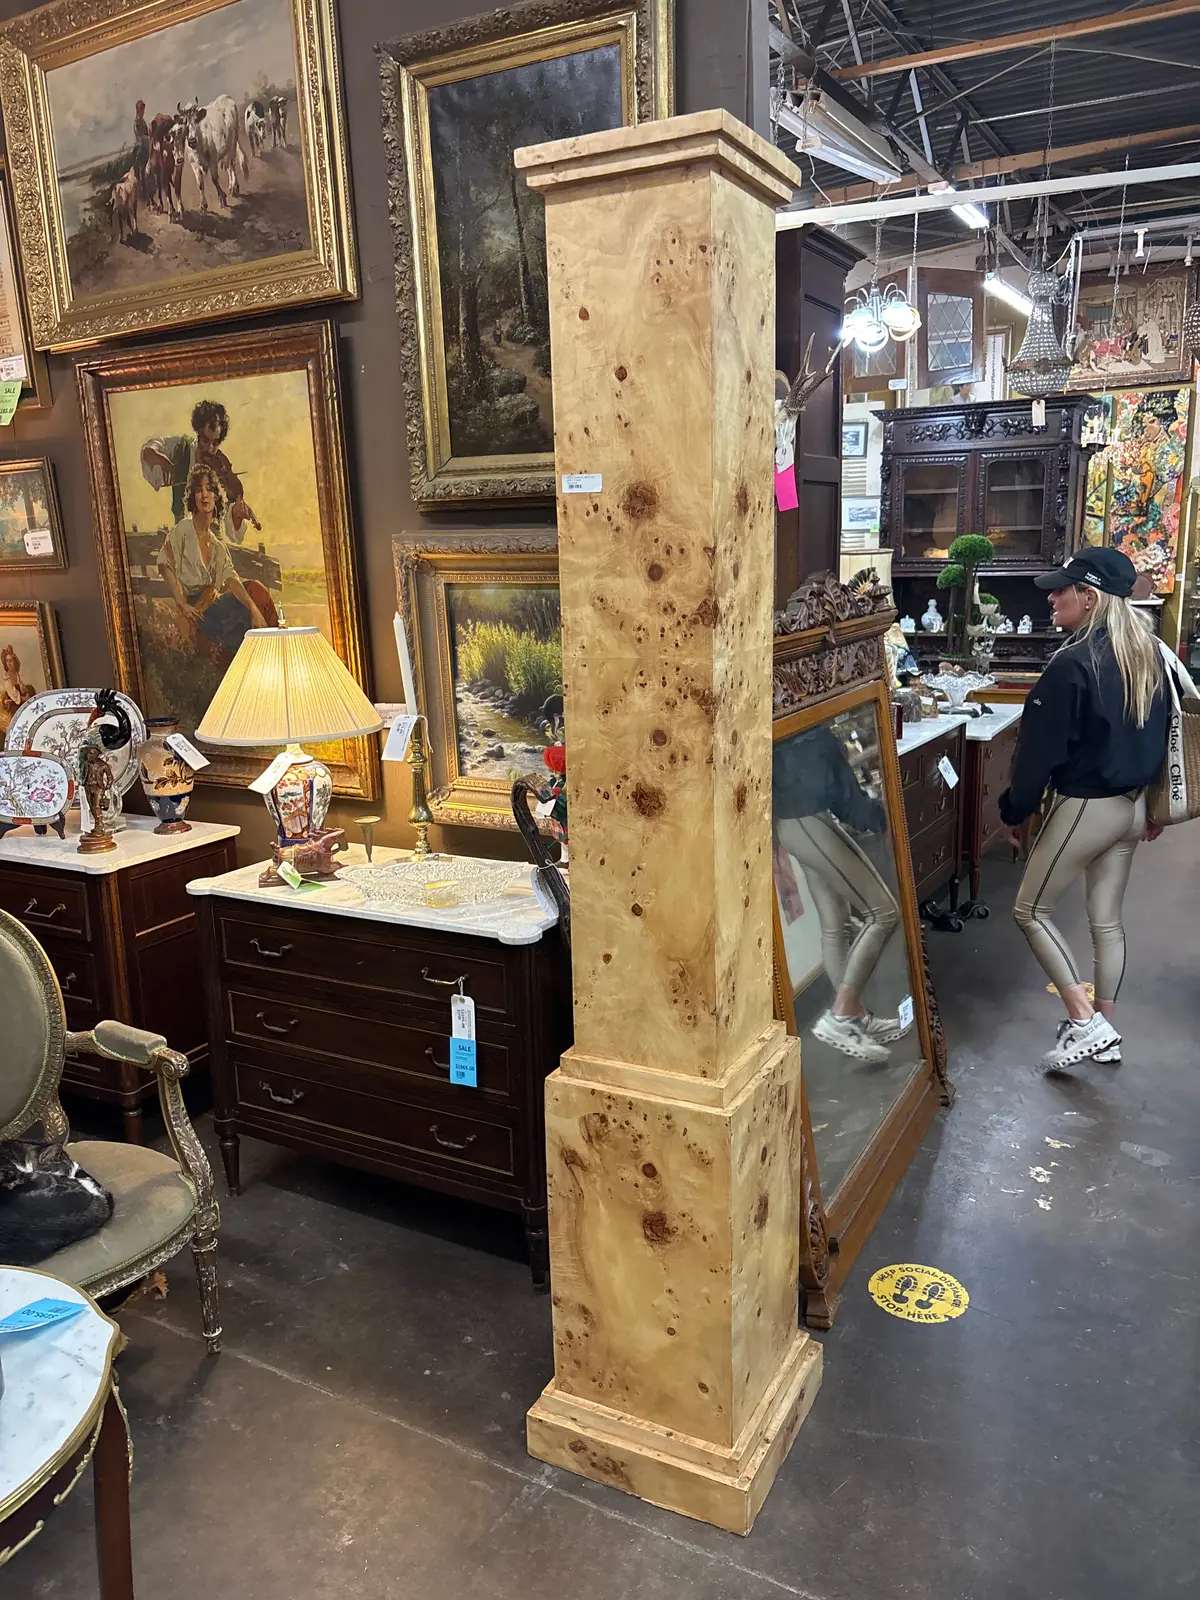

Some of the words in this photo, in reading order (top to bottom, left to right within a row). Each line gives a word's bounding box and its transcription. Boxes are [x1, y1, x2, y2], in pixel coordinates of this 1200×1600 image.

[1169, 714, 1180, 753] Chloé
[1170, 763, 1183, 801] Chloé
[458, 1044, 472, 1053] SALE
[876, 1268, 897, 1282] KEEP
[898, 1266, 940, 1279] SOCIAL
[938, 1275, 963, 1308] DISTANCE
[876, 1294, 904, 1313] STOP
[906, 1310, 941, 1321] HERE
